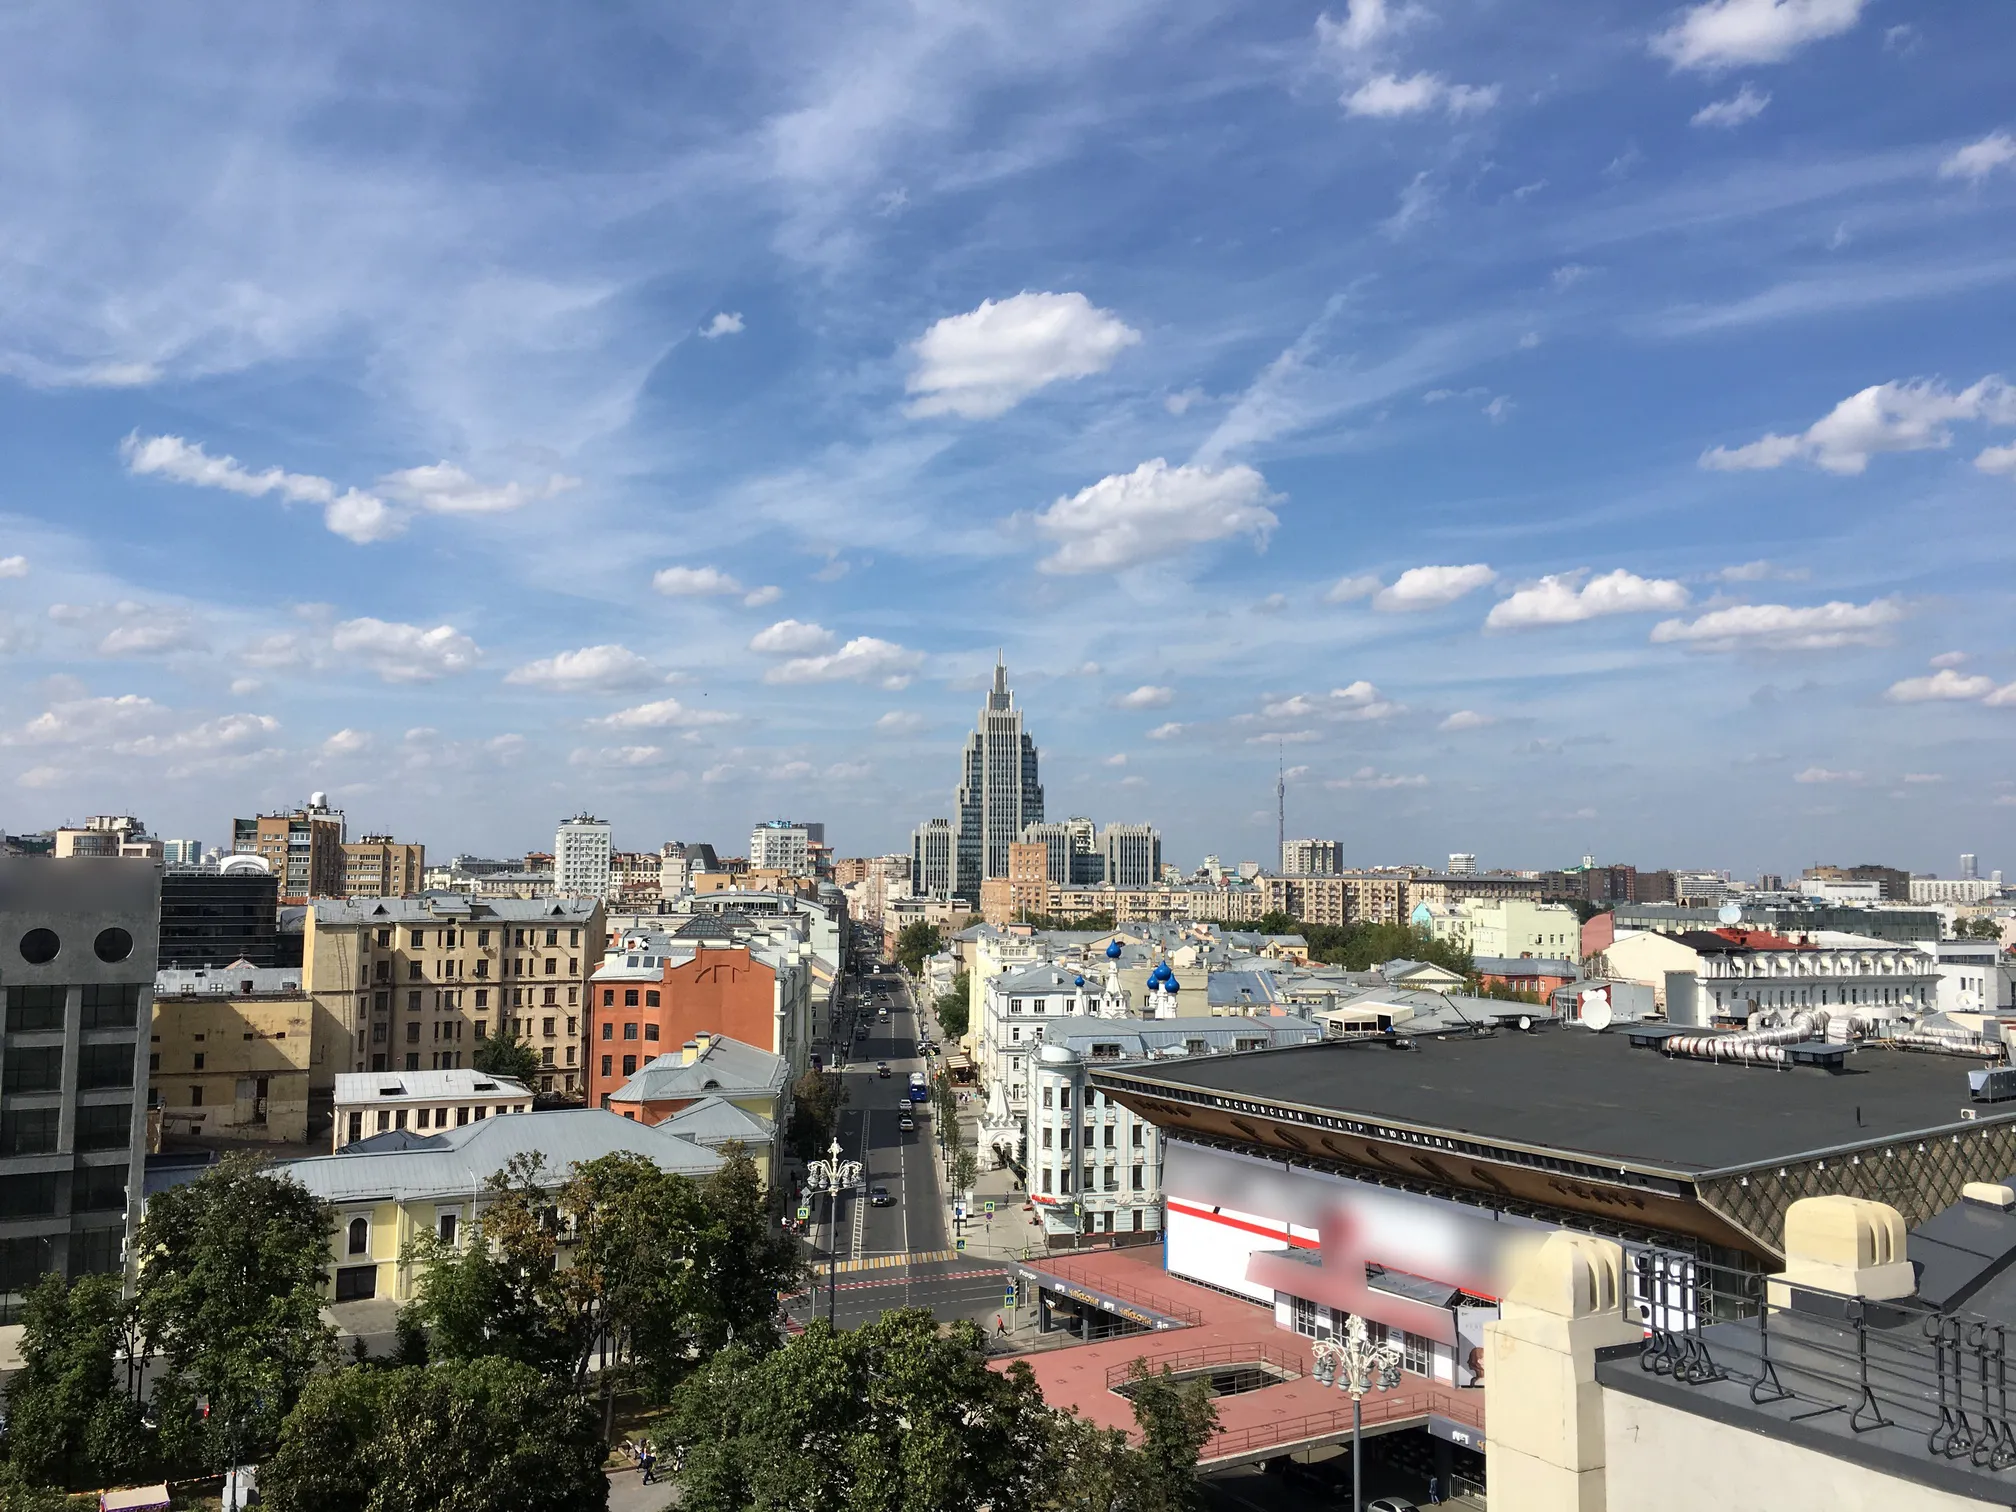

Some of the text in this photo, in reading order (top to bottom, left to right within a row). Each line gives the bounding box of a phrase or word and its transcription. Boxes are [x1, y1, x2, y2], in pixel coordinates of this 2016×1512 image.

[1216, 1098, 1304, 1121] МОСКОВСКИЙ
[1316, 1116, 1363, 1132] ТЕАТР
[1378, 1128, 1454, 1149] МЮЗИКЛА
